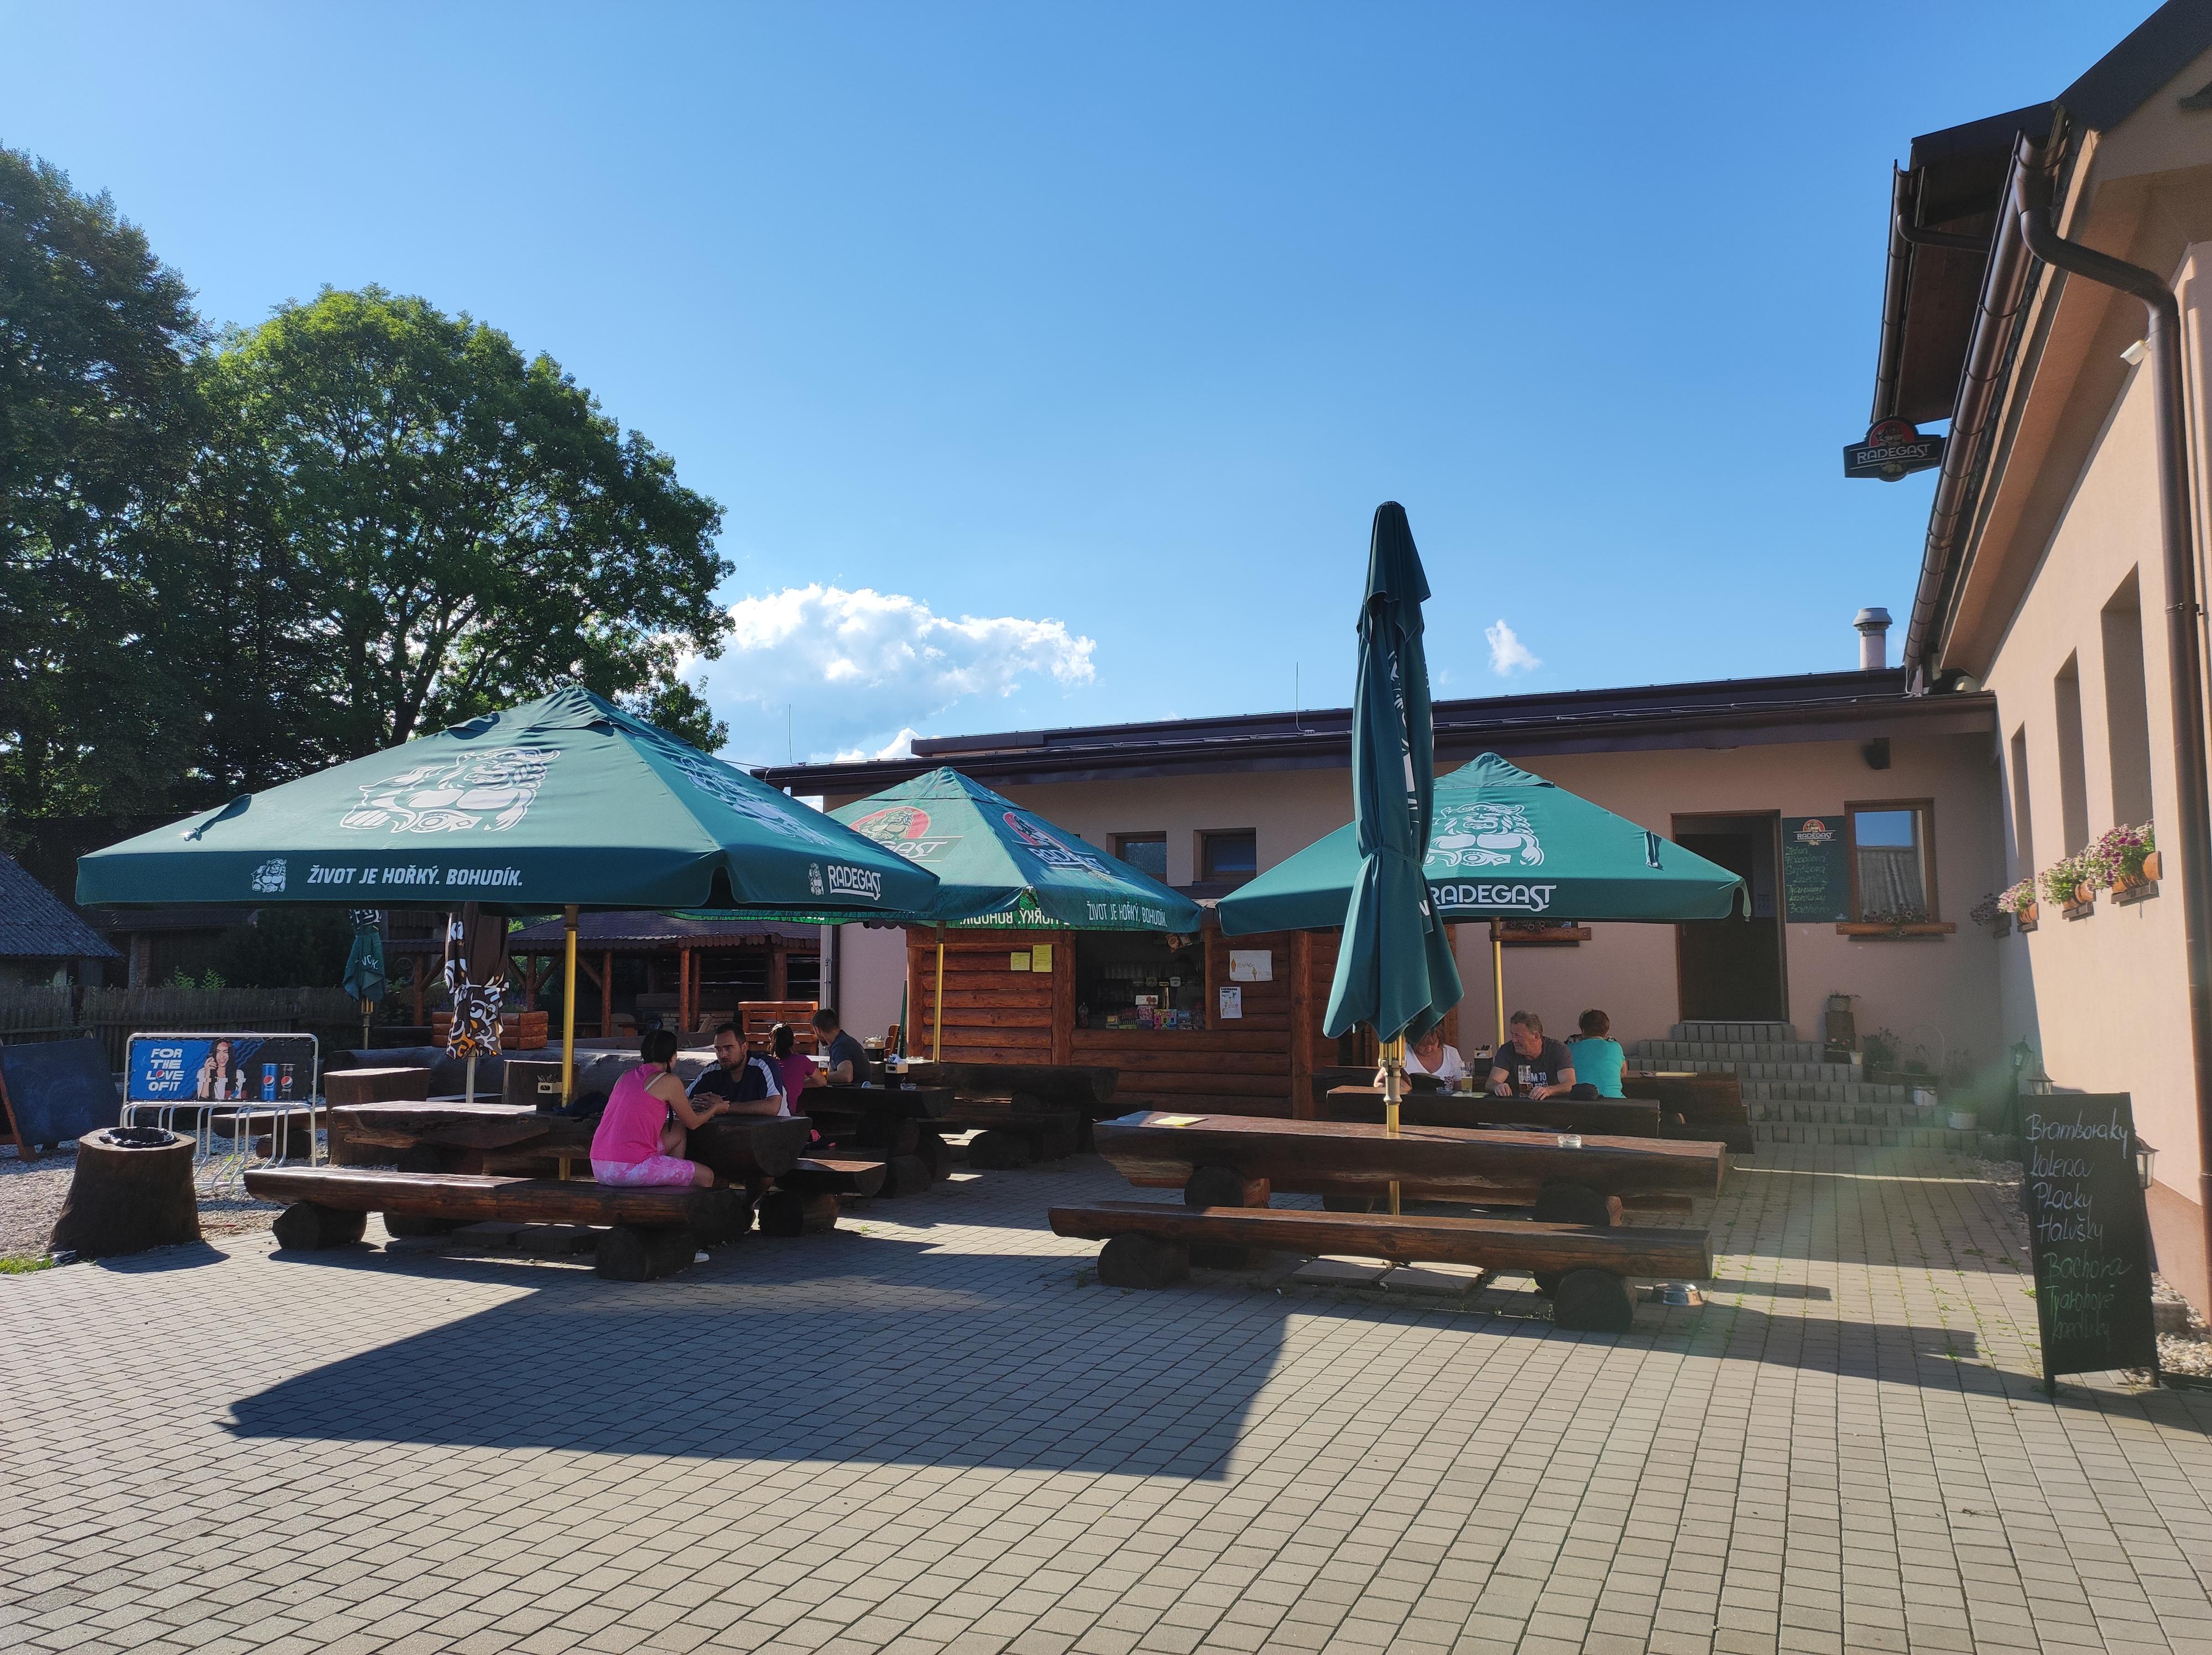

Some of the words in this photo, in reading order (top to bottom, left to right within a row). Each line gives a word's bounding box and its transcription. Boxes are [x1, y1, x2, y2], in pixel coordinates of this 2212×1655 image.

[1856, 443, 1931, 464] RADEGAST
[875, 840, 948, 859] GAST
[307, 864, 357, 884] ŽIVOT
[358, 868, 379, 885] JE
[382, 864, 440, 885] HOŘKÝ.
[446, 866, 523, 886] BOHUDÍK.
[827, 865, 881, 901] RADEGAST
[1431, 885, 1557, 912] RADEGAST
[1086, 900, 1107, 921] ŽIVOT
[1110, 904, 1117, 921] JE
[1118, 901, 1140, 922] HOŘKÝ.
[150, 1048, 183, 1058] FOR
[150, 1059, 182, 1069] THE
